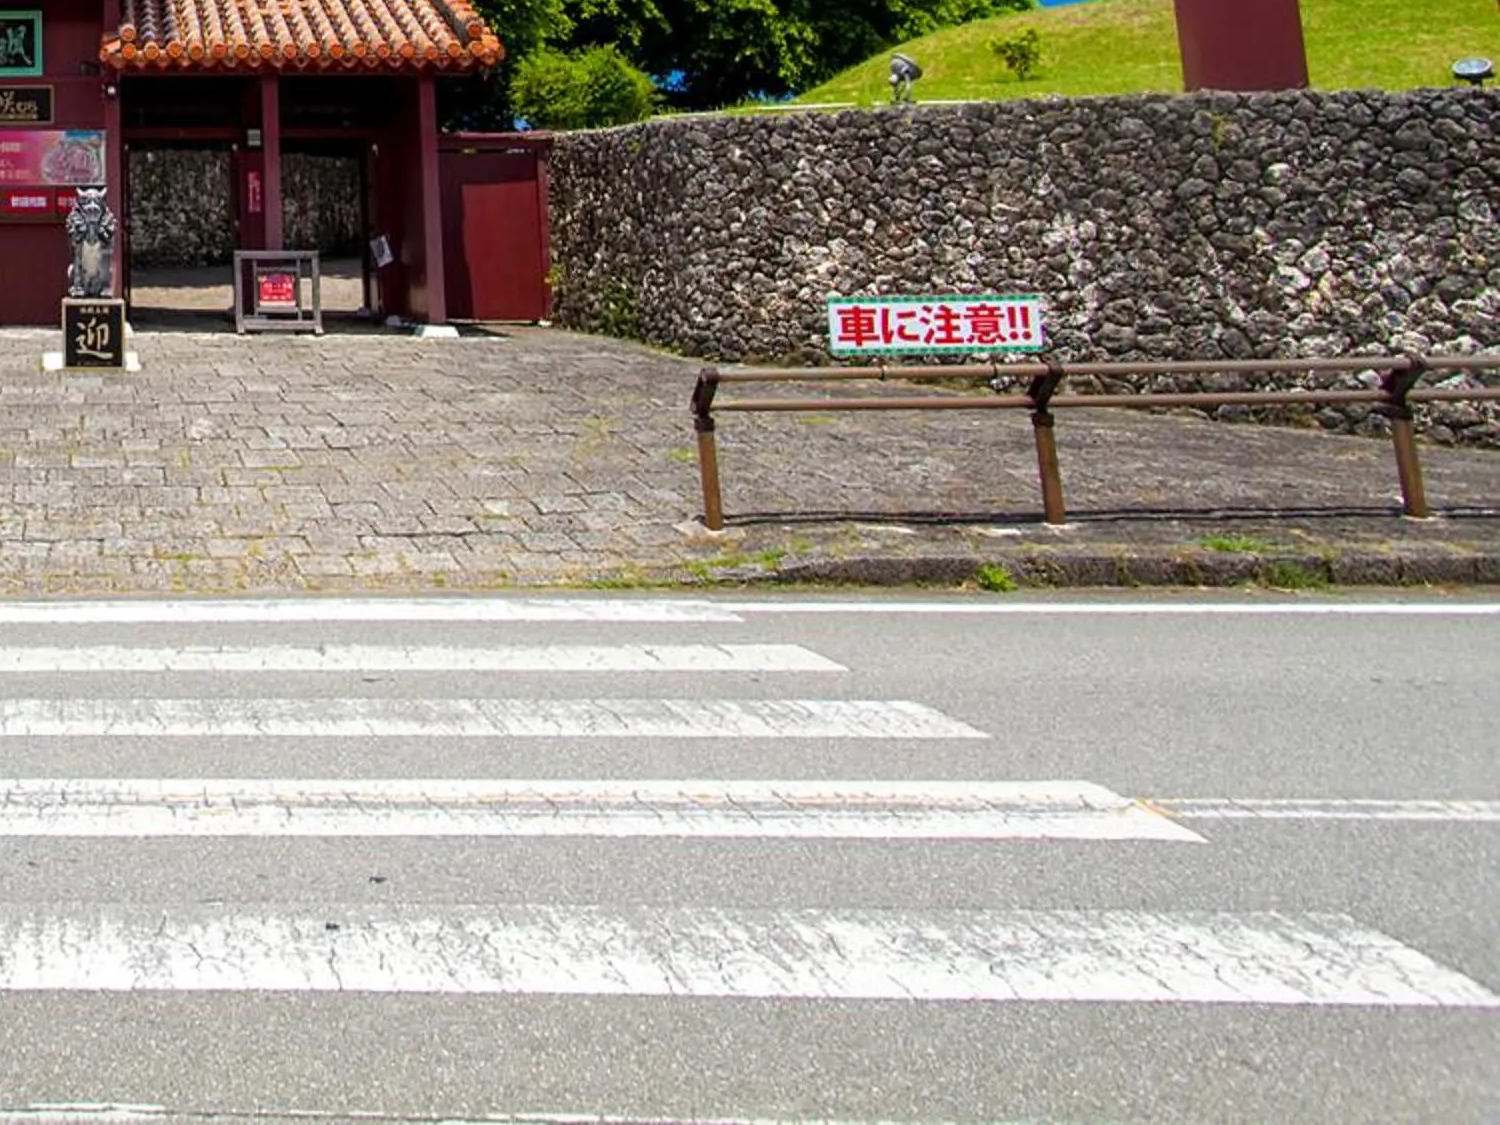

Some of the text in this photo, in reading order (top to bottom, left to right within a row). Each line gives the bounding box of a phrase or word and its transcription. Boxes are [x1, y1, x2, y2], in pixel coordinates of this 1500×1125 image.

[75, 316, 114, 359] 迎
[836, 303, 1033, 347] 車に注意!!
